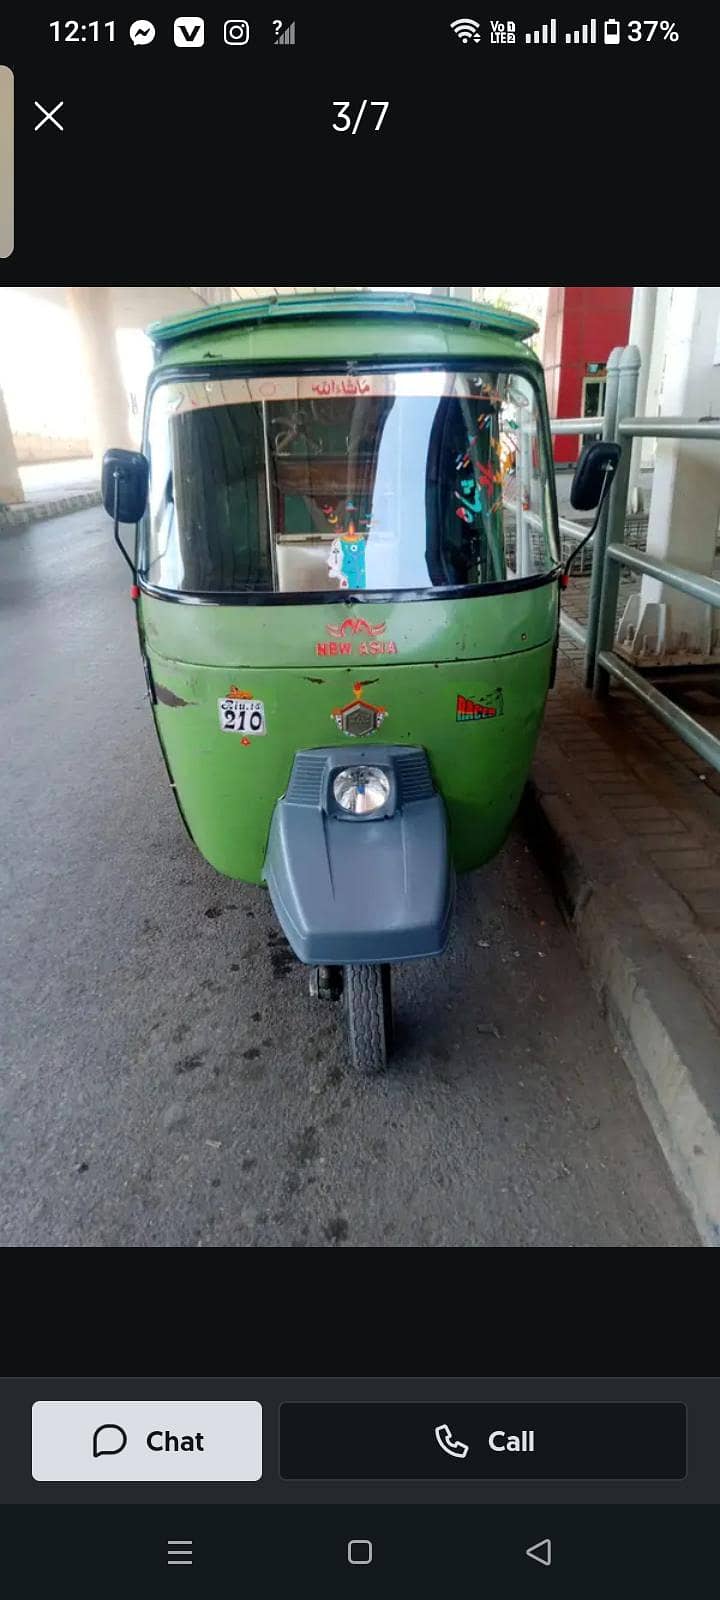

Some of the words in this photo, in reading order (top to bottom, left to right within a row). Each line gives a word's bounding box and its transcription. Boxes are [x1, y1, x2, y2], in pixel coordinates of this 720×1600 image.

[316, 642, 352, 656] NEW
[358, 640, 398, 655] ASIA
[223, 709, 263, 732] 210
